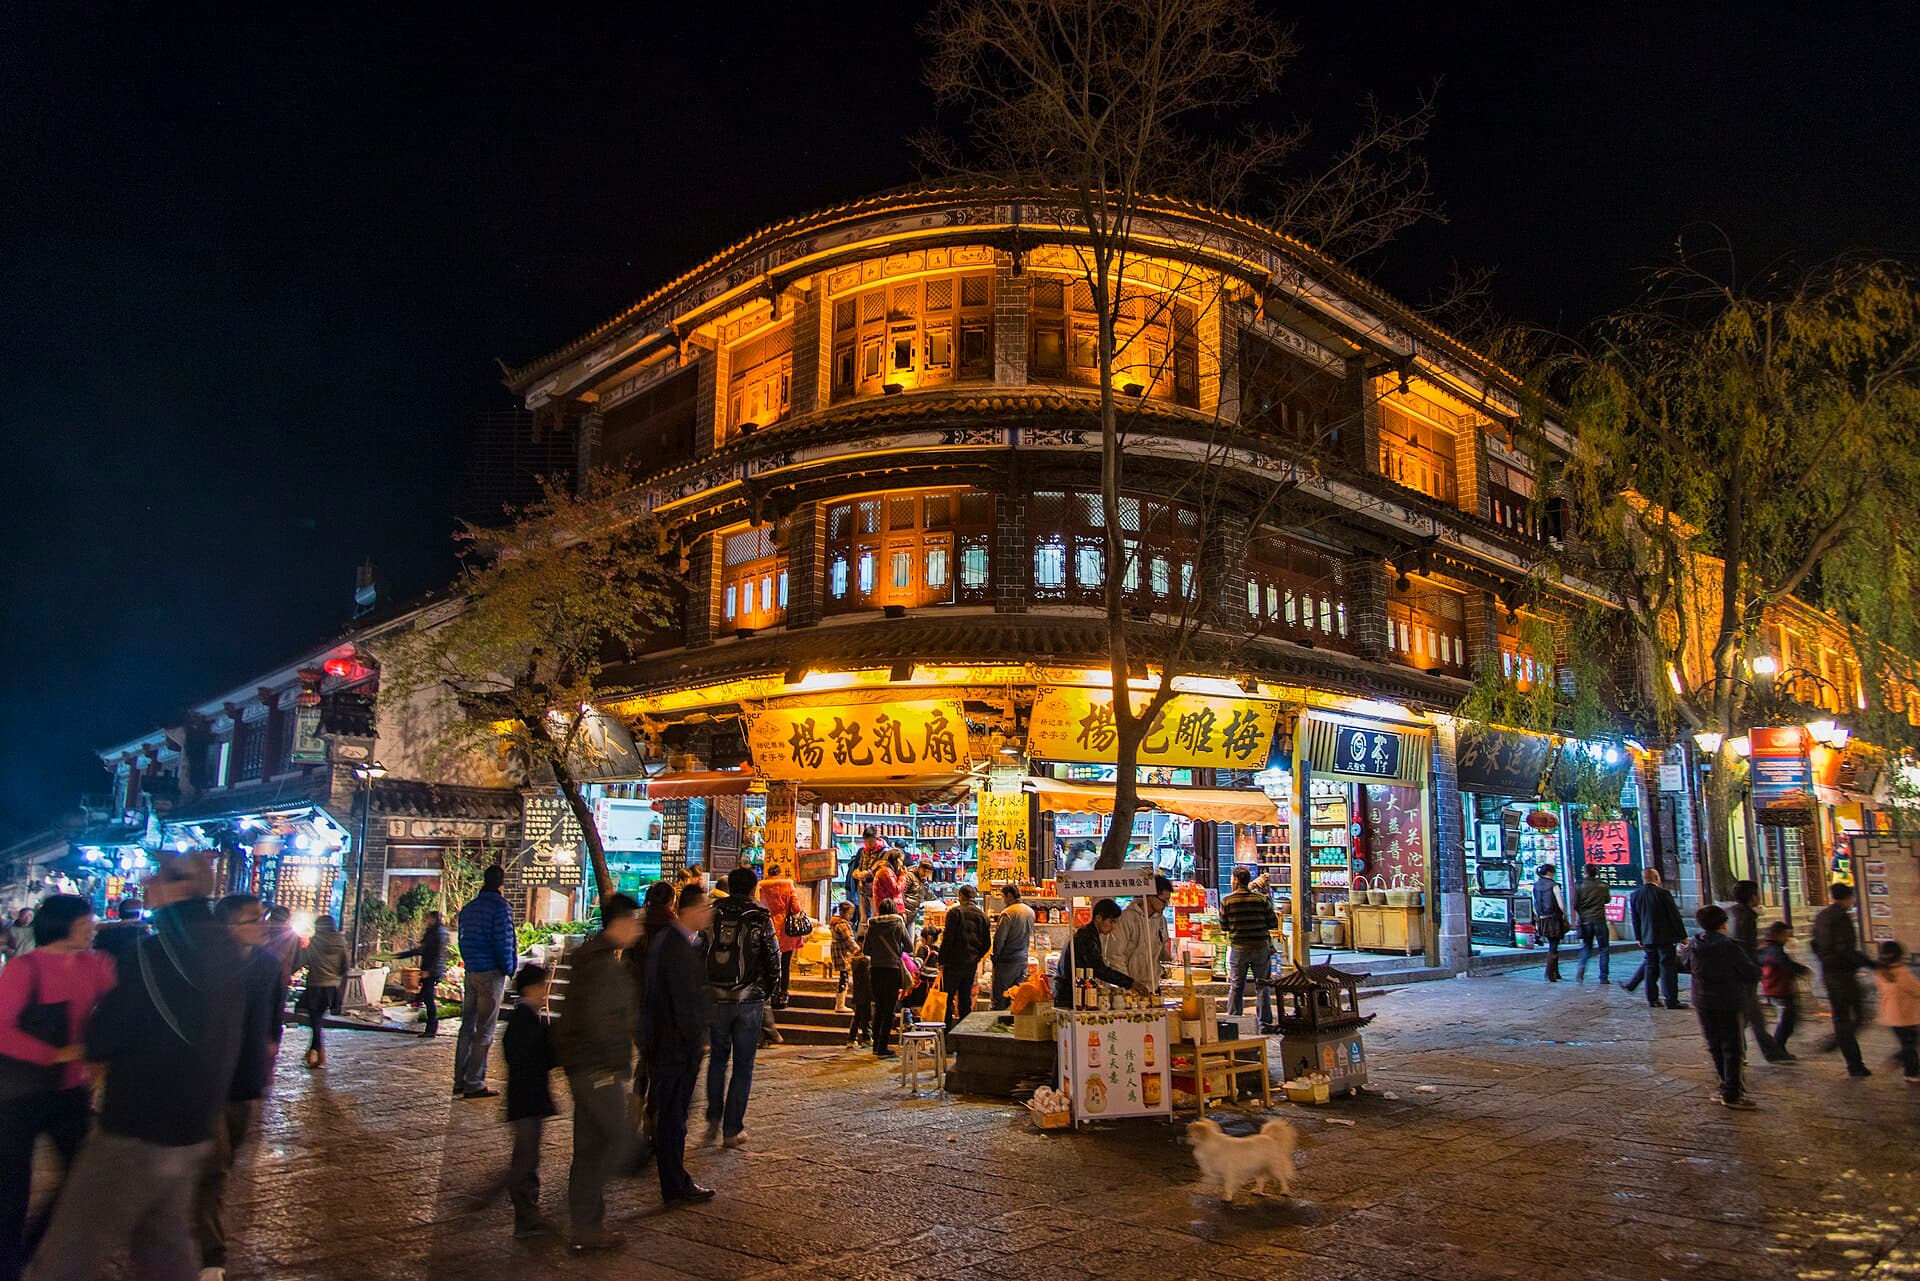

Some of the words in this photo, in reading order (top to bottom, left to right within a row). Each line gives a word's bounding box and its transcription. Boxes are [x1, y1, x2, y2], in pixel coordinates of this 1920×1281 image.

[787, 708, 958, 769] 楊記乳扇
[980, 829, 1027, 852] 烤乳扇
[1585, 820, 1625, 842] 杨氏
[1586, 843, 1628, 863] 梅子
